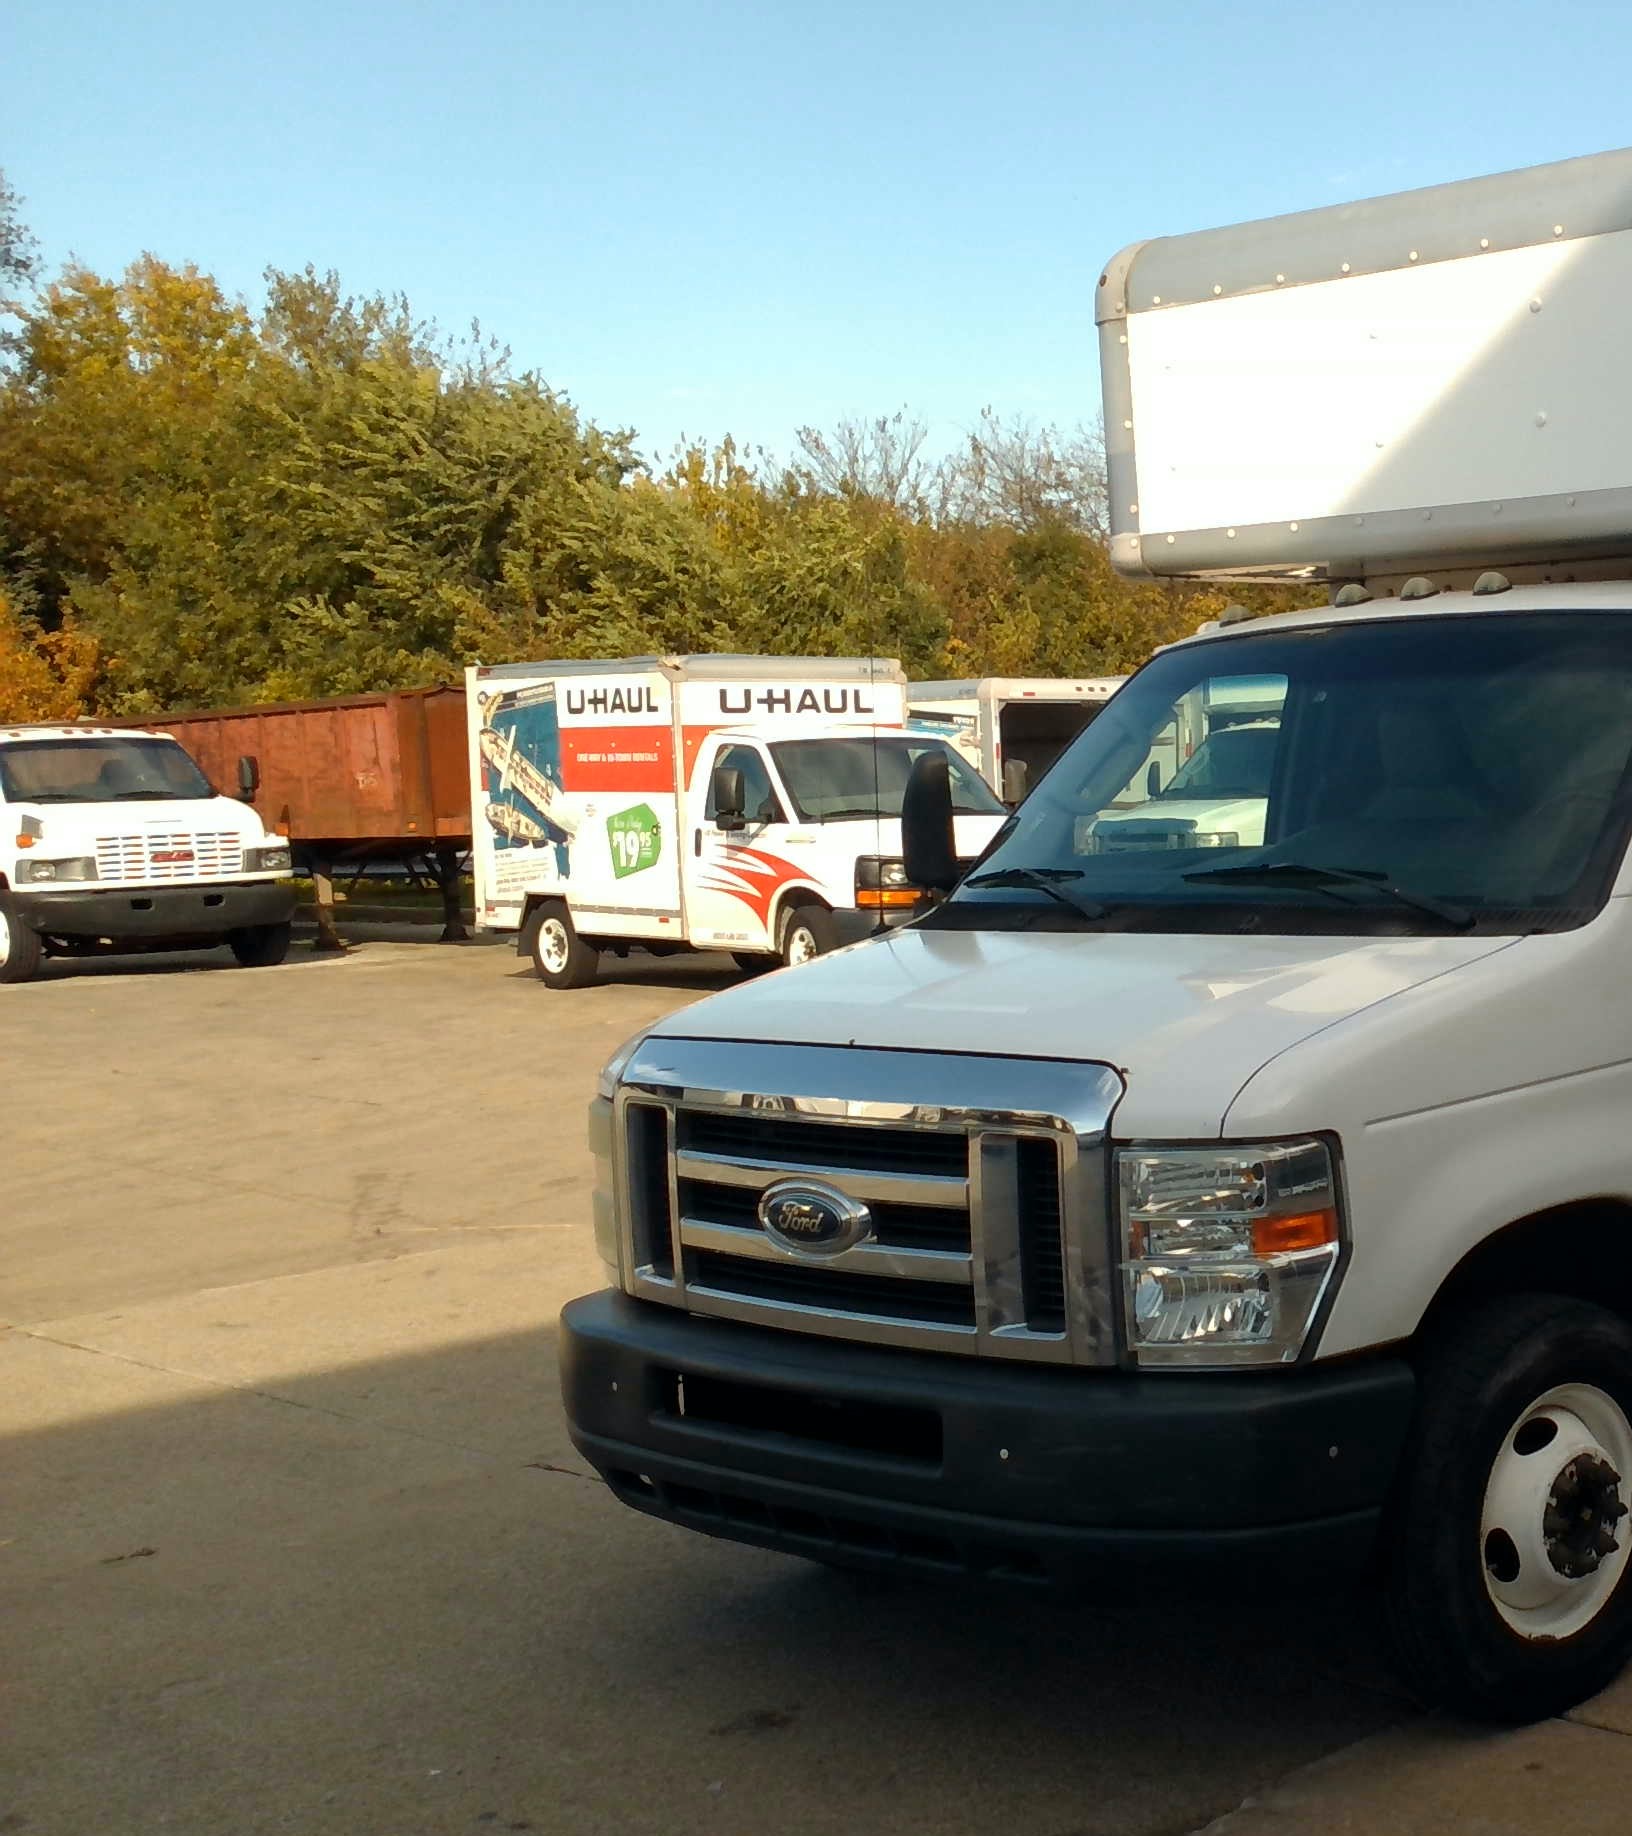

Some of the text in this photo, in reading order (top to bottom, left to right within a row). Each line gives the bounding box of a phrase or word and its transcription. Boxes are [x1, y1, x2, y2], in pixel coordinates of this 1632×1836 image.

[566, 687, 659, 714] U-HAUL
[719, 688, 874, 714] U-HAUL
[778, 1200, 824, 1233] Ford
